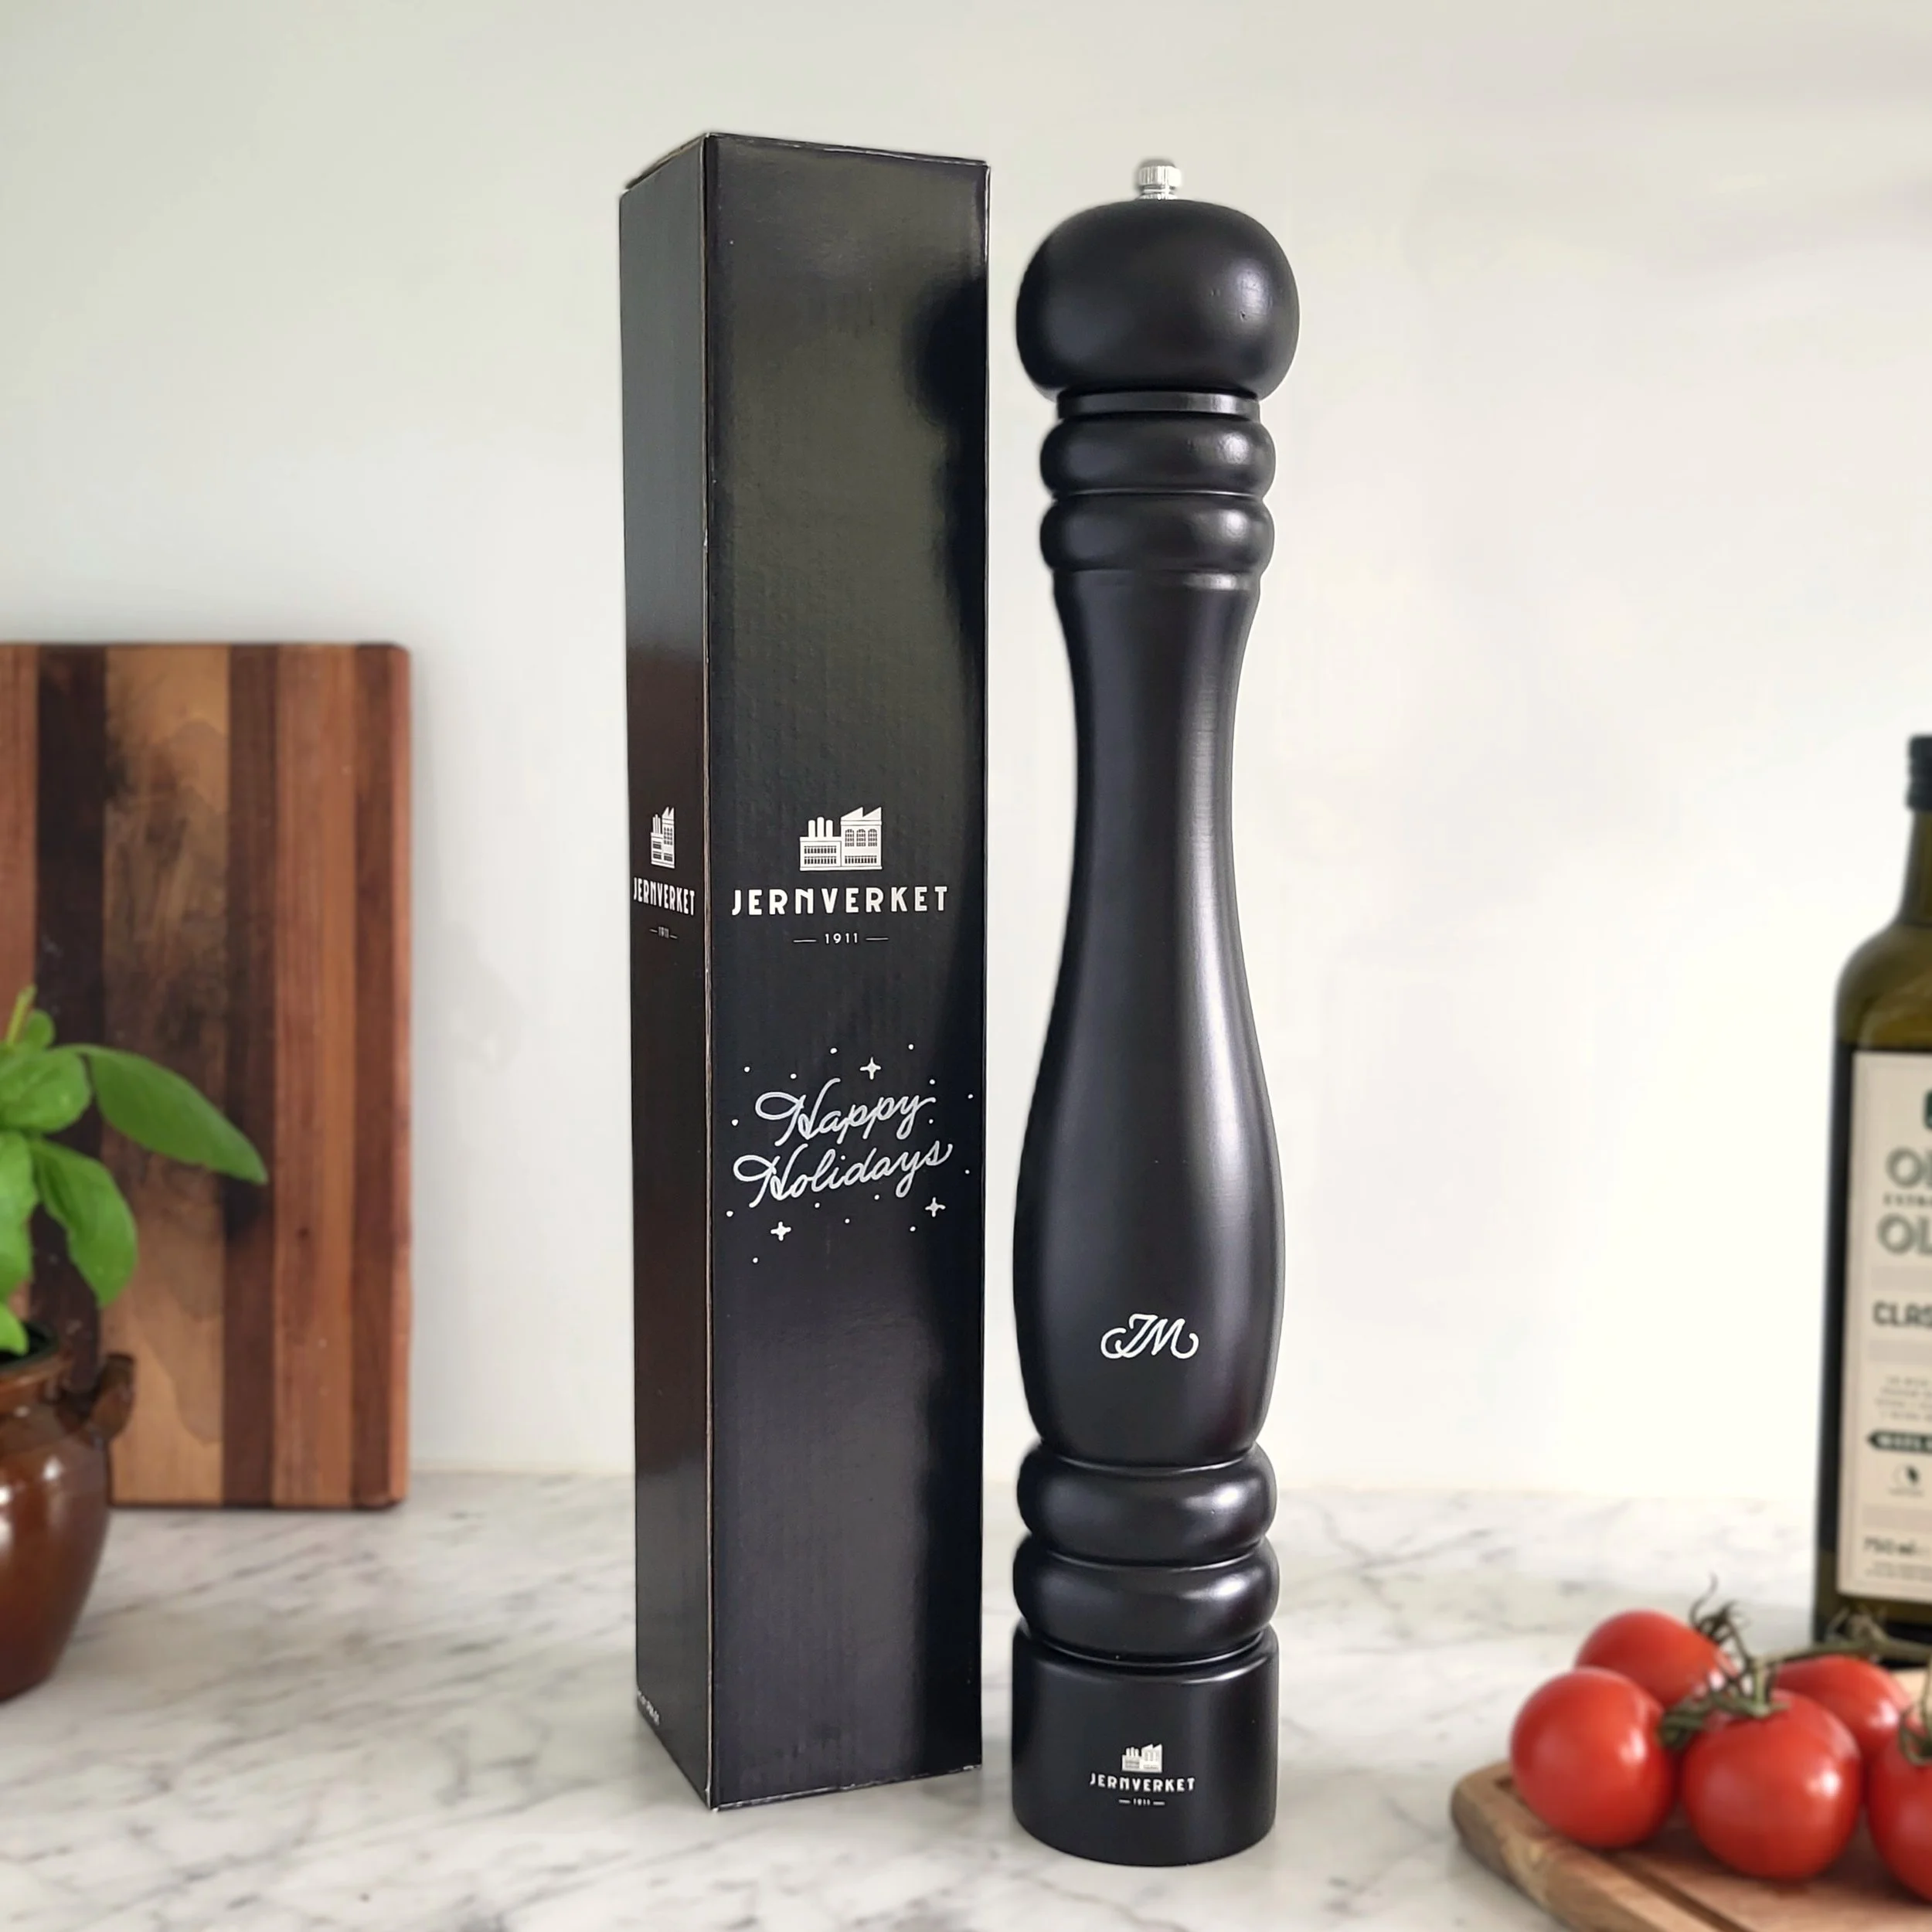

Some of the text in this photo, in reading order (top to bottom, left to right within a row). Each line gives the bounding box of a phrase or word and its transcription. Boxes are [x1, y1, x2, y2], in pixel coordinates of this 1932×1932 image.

[634, 877, 696, 916] JERNVERKET
[731, 886, 949, 916] JERNVERKET
[824, 932, 859, 944] 1911
[754, 1077, 937, 1147] Happy
[733, 1140, 954, 1209] Holidays
[1090, 1772, 1196, 1793] JERNVERKET
